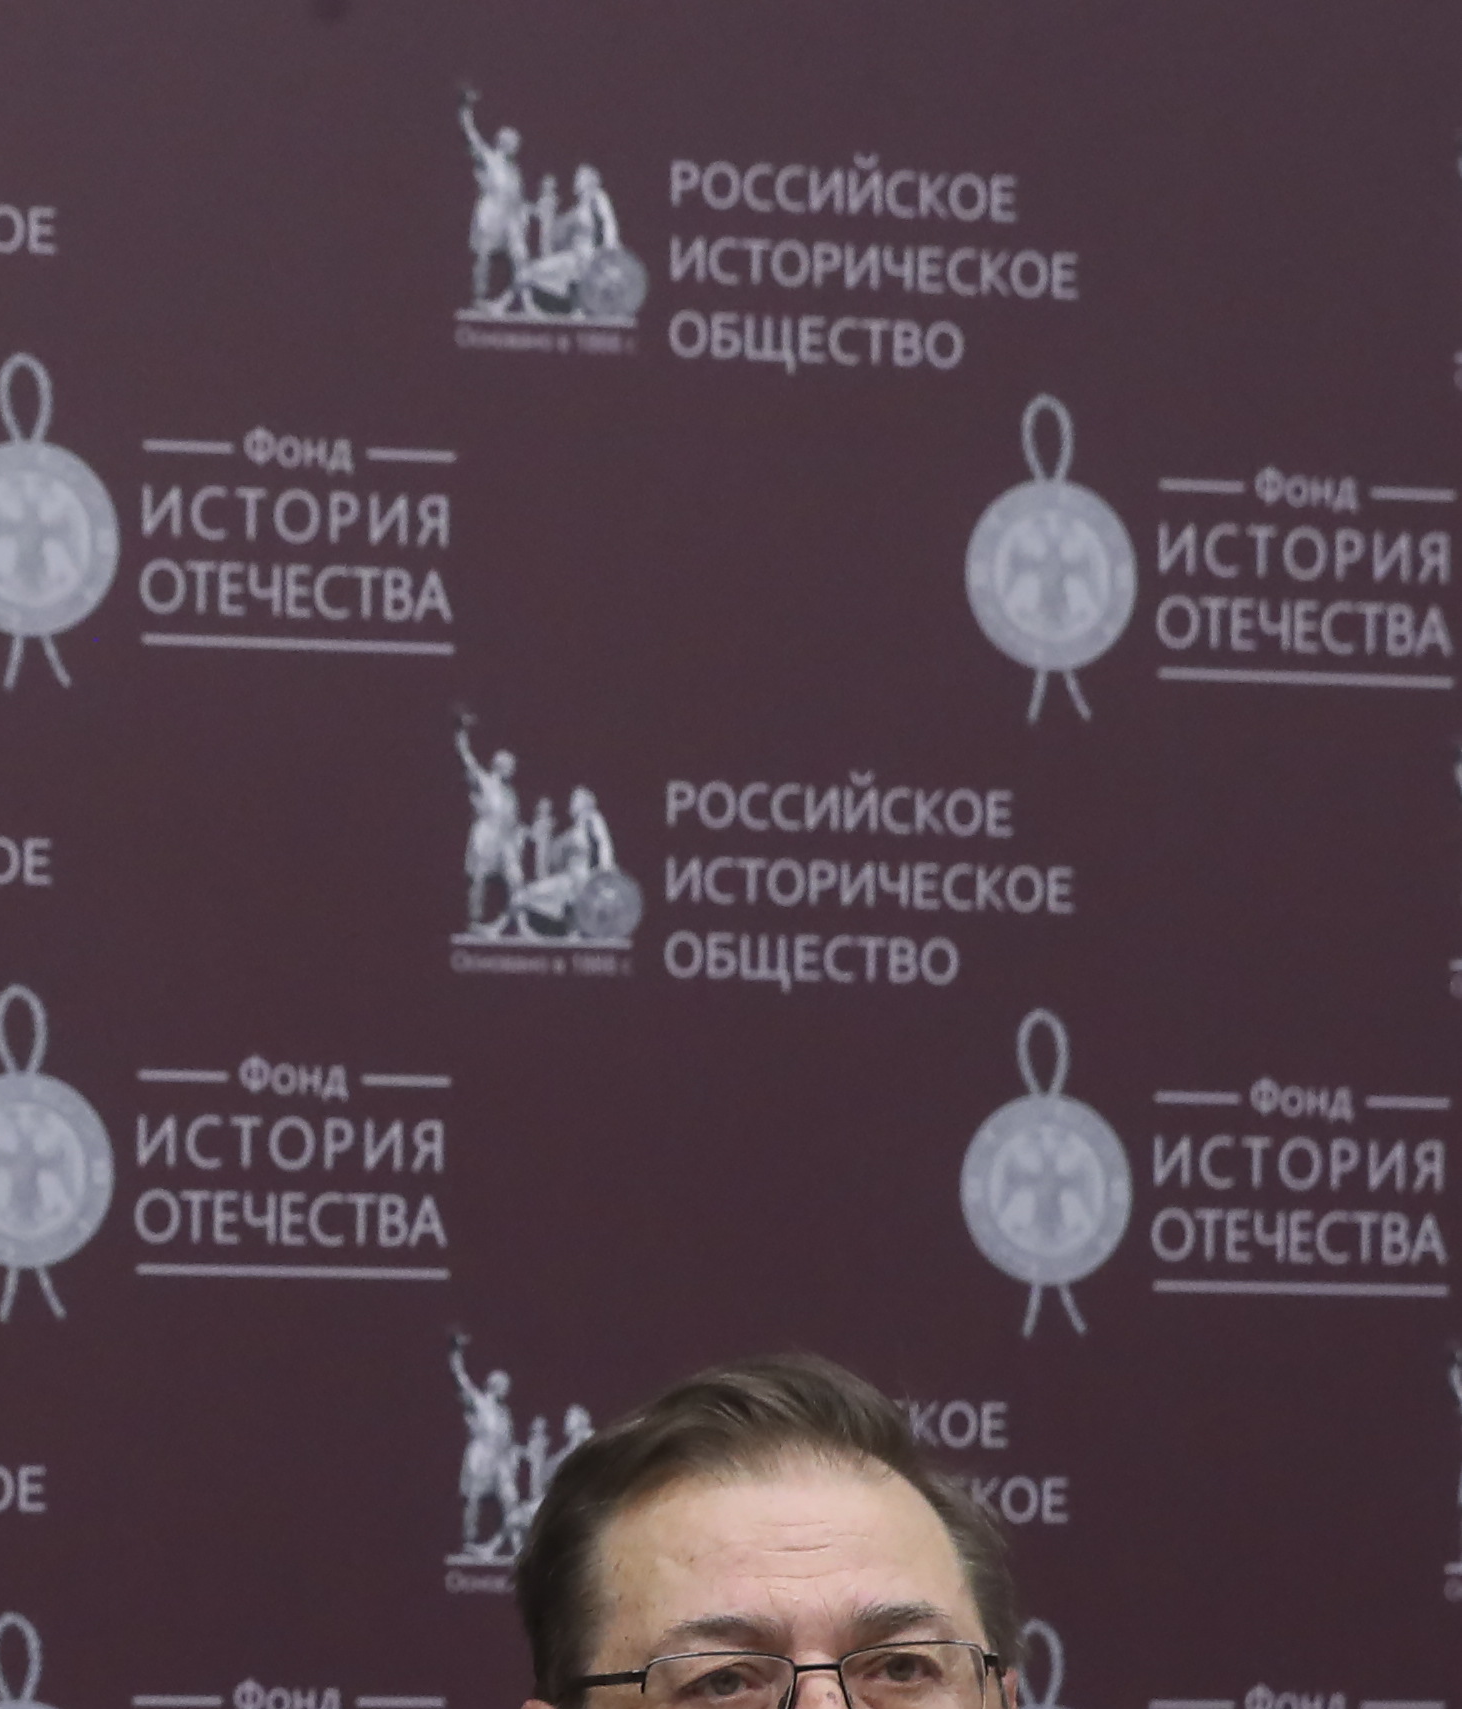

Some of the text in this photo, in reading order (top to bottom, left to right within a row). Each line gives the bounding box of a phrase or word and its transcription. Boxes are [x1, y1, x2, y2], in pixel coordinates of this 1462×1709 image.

[670, 154, 1015, 222] РОССИЙСКОЕ
[670, 237, 1077, 300] ИСТОРИЧЕСКОЕ
[669, 310, 964, 373] ОБЩЕСТВО
[244, 426, 354, 473] Фонд
[142, 485, 449, 546] ИСТОРИЯ
[1255, 466, 1359, 512] Фонд
[1158, 523, 1450, 583] ИСТОРИЯ
[139, 558, 452, 621] ОТЕЧЕСТВА
[1156, 595, 1452, 656] ОТЕЧЕСТВА
[666, 771, 1012, 837] РОССИЙСКОЕ
[666, 857, 1072, 913] ИСТОРИЧЕСКОЕ
[664, 931, 959, 992] ОБЩЕСТВО
[239, 1055, 349, 1100] Фонд
[1250, 1077, 1354, 1122] Фонд
[137, 1114, 444, 1171] ИСТОРИЯ
[1153, 1135, 1444, 1190] ИСТОРИЯ
[134, 1188, 446, 1247] ОТЕЧЕСТВА
[1151, 1207, 1446, 1265] ОТЕЧЕСТВА
